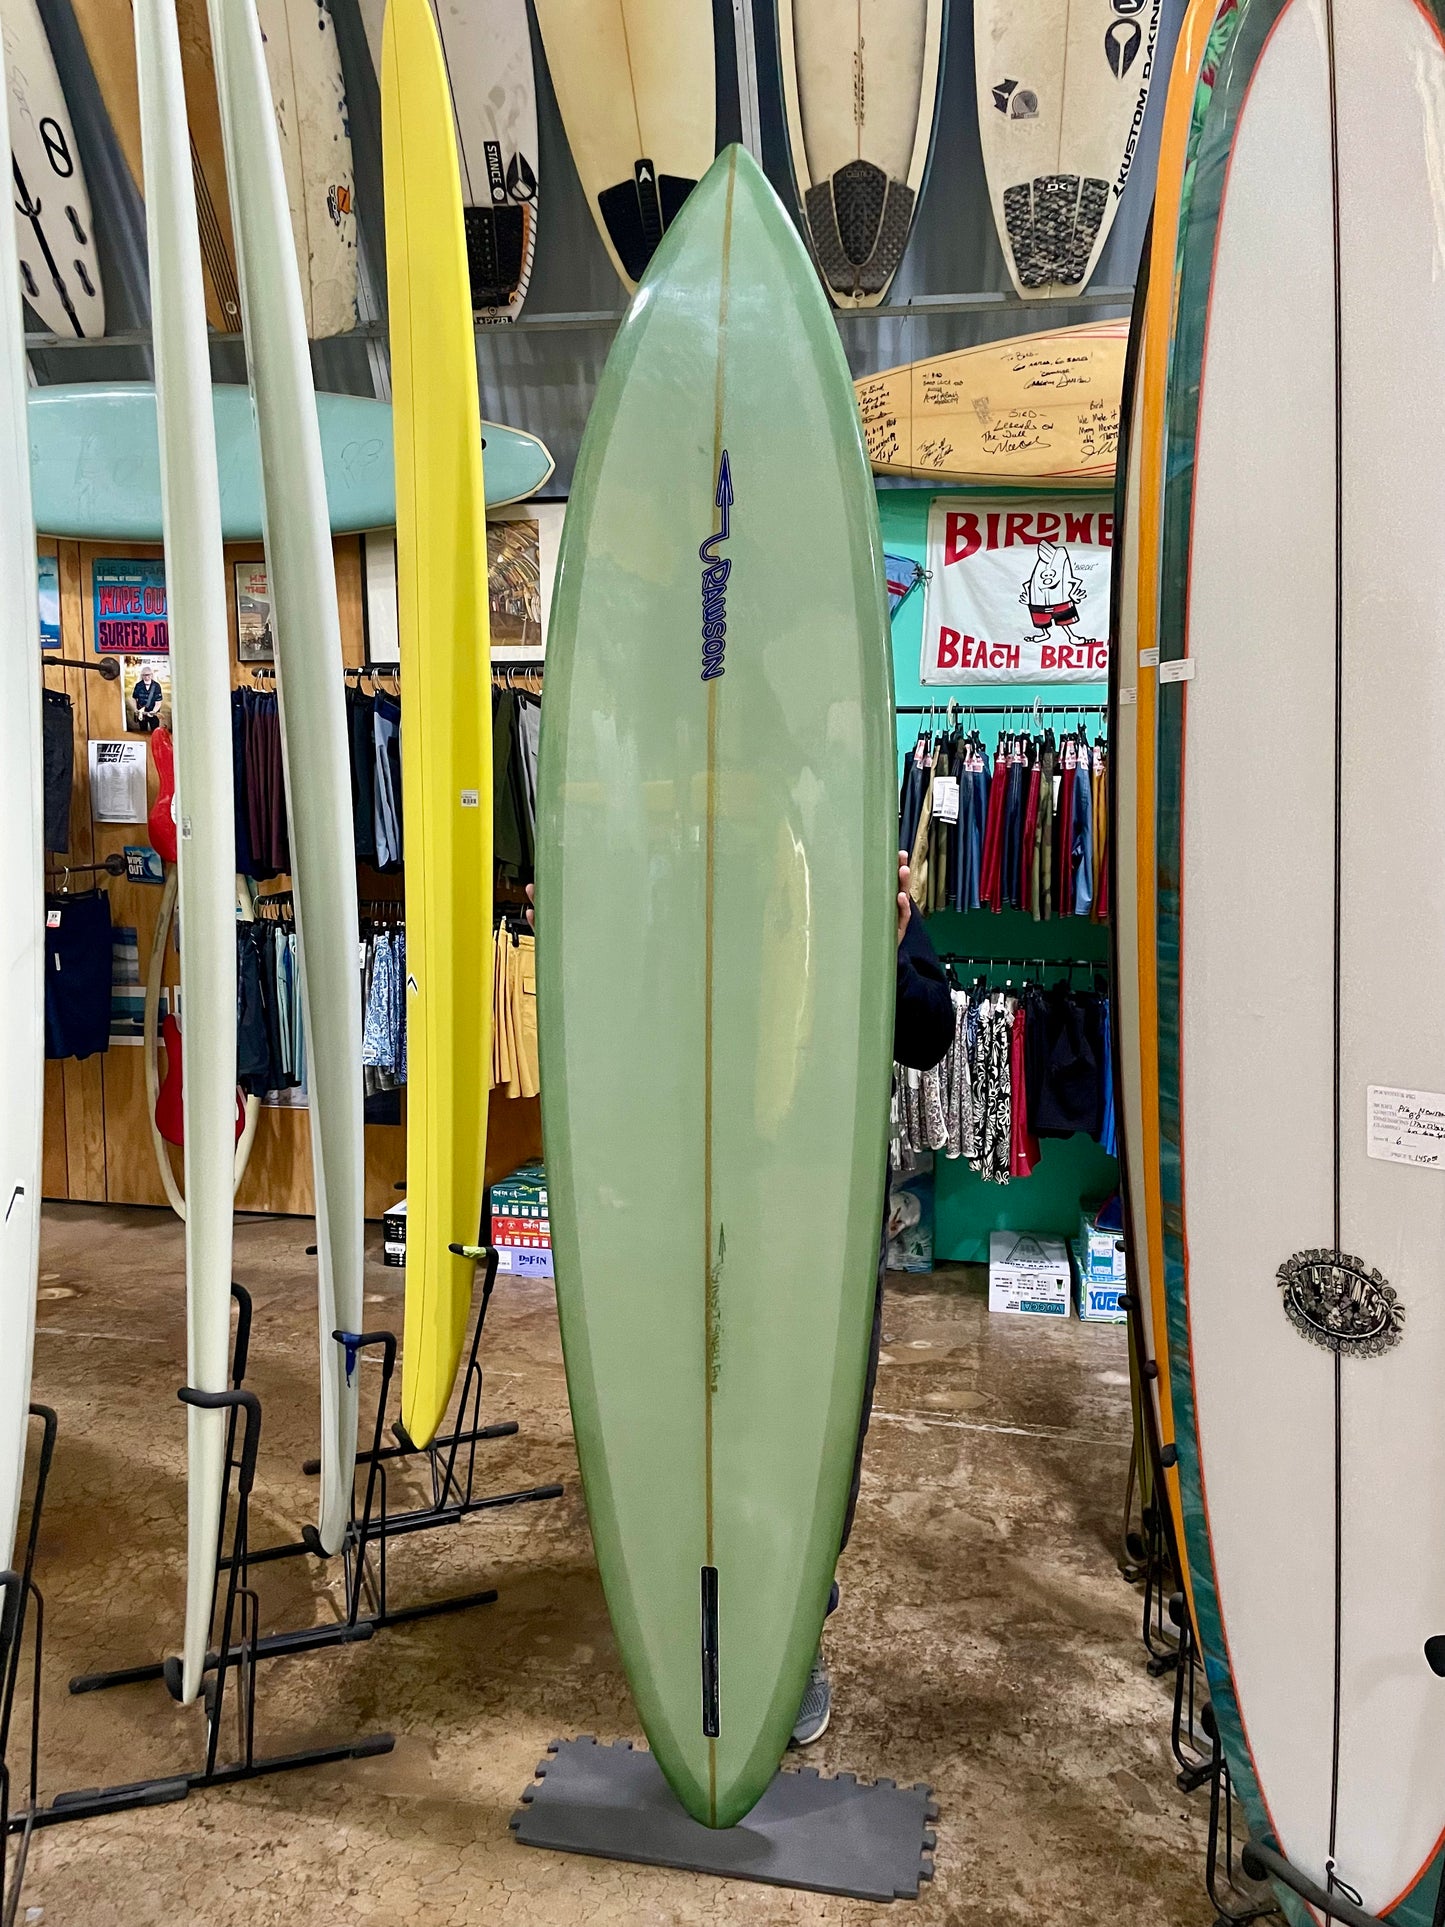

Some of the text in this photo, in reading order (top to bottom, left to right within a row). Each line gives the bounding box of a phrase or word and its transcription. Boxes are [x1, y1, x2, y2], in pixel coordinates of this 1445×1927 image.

[1117, 88, 1148, 185] KUSTOM
[487, 145, 502, 184] STANCE
[981, 430, 999, 443] The
[99, 586, 142, 615] WIPE
[99, 621, 169, 647] SURFER JO
[700, 559, 732, 682] RAWSON
[937, 626, 1020, 669] BEACH
[126, 856, 143, 865] WIPE
[128, 865, 144, 875] OUT
[1368, 1267, 1398, 1303] PIG
[1283, 1303, 1395, 1355] LONGBOARDS
